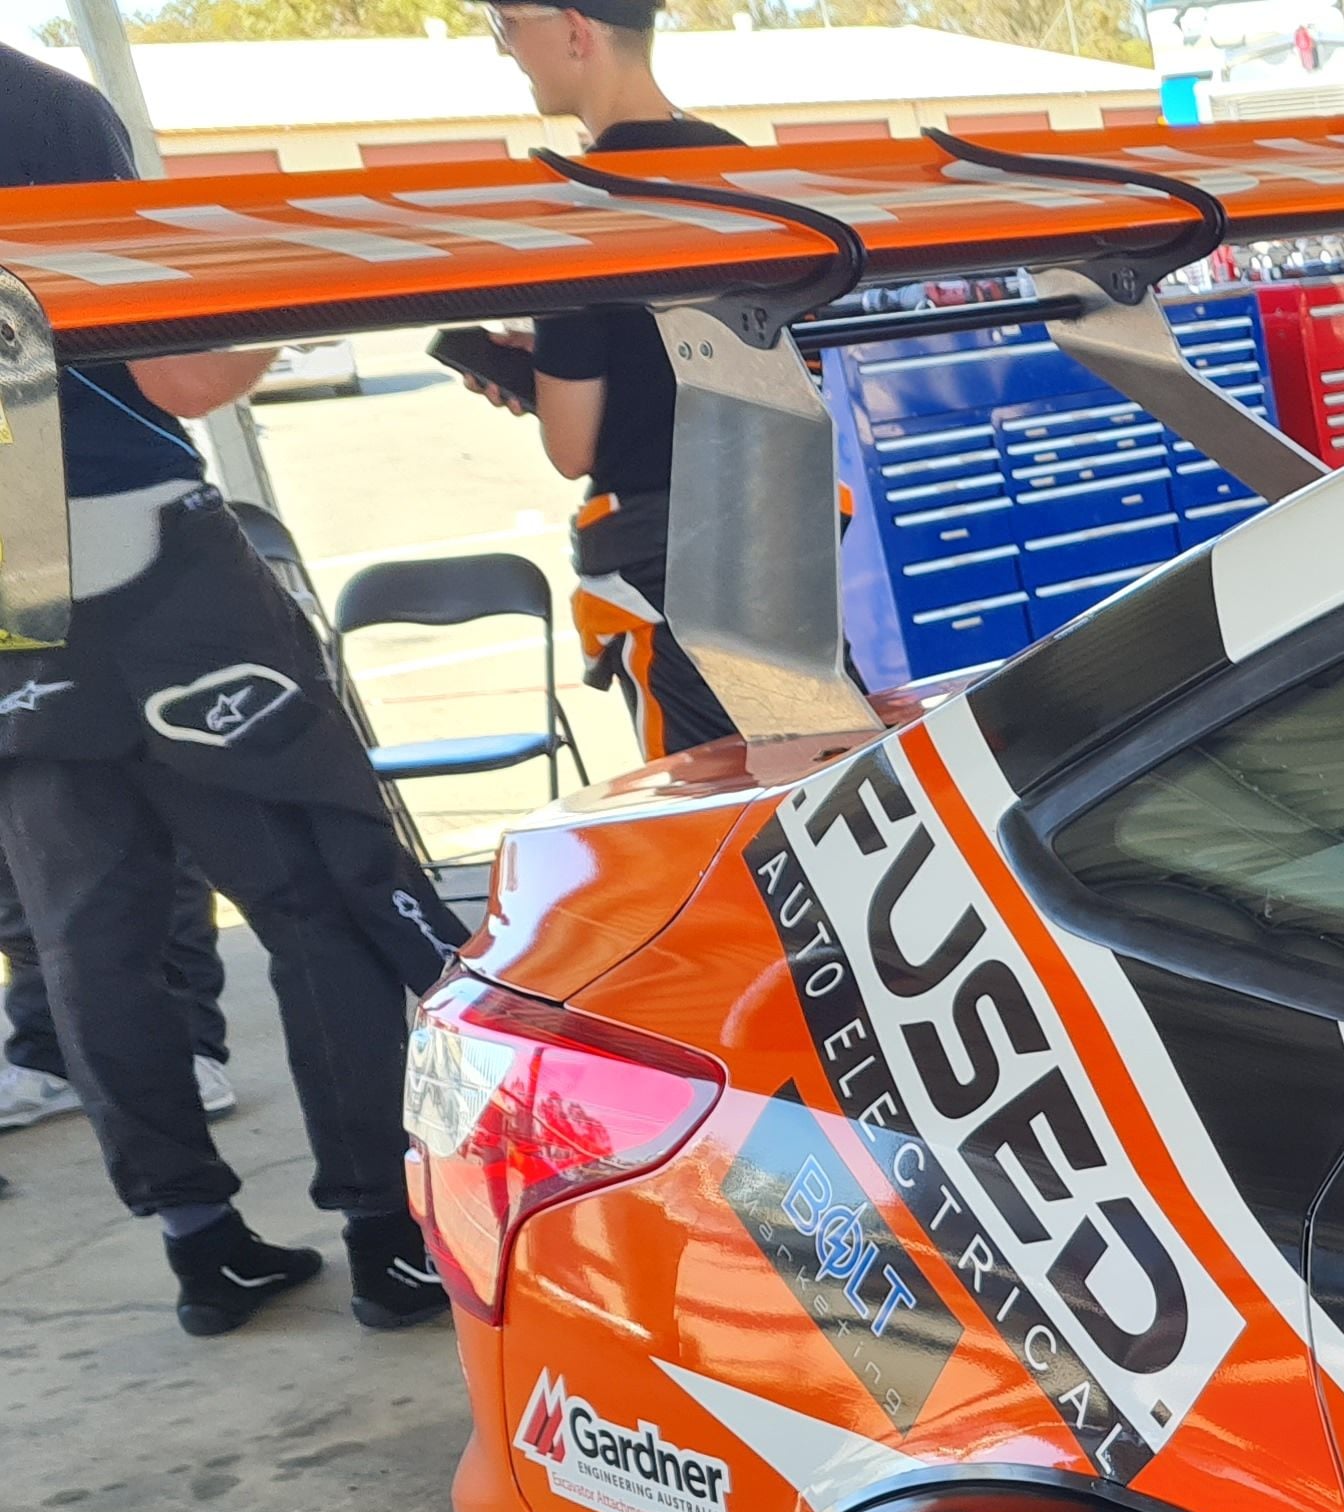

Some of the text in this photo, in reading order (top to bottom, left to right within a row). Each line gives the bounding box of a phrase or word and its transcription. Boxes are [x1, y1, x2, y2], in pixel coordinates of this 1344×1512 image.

[805, 745, 1189, 1374] FUSED
[757, 850, 1124, 1471] AUTO ELECTRICAL
[781, 1154, 916, 1338] BOLT
[552, 1472, 596, 1502] Excavator
[569, 1406, 723, 1504] Gardner
[577, 1461, 653, 1500] ENGINEERING
